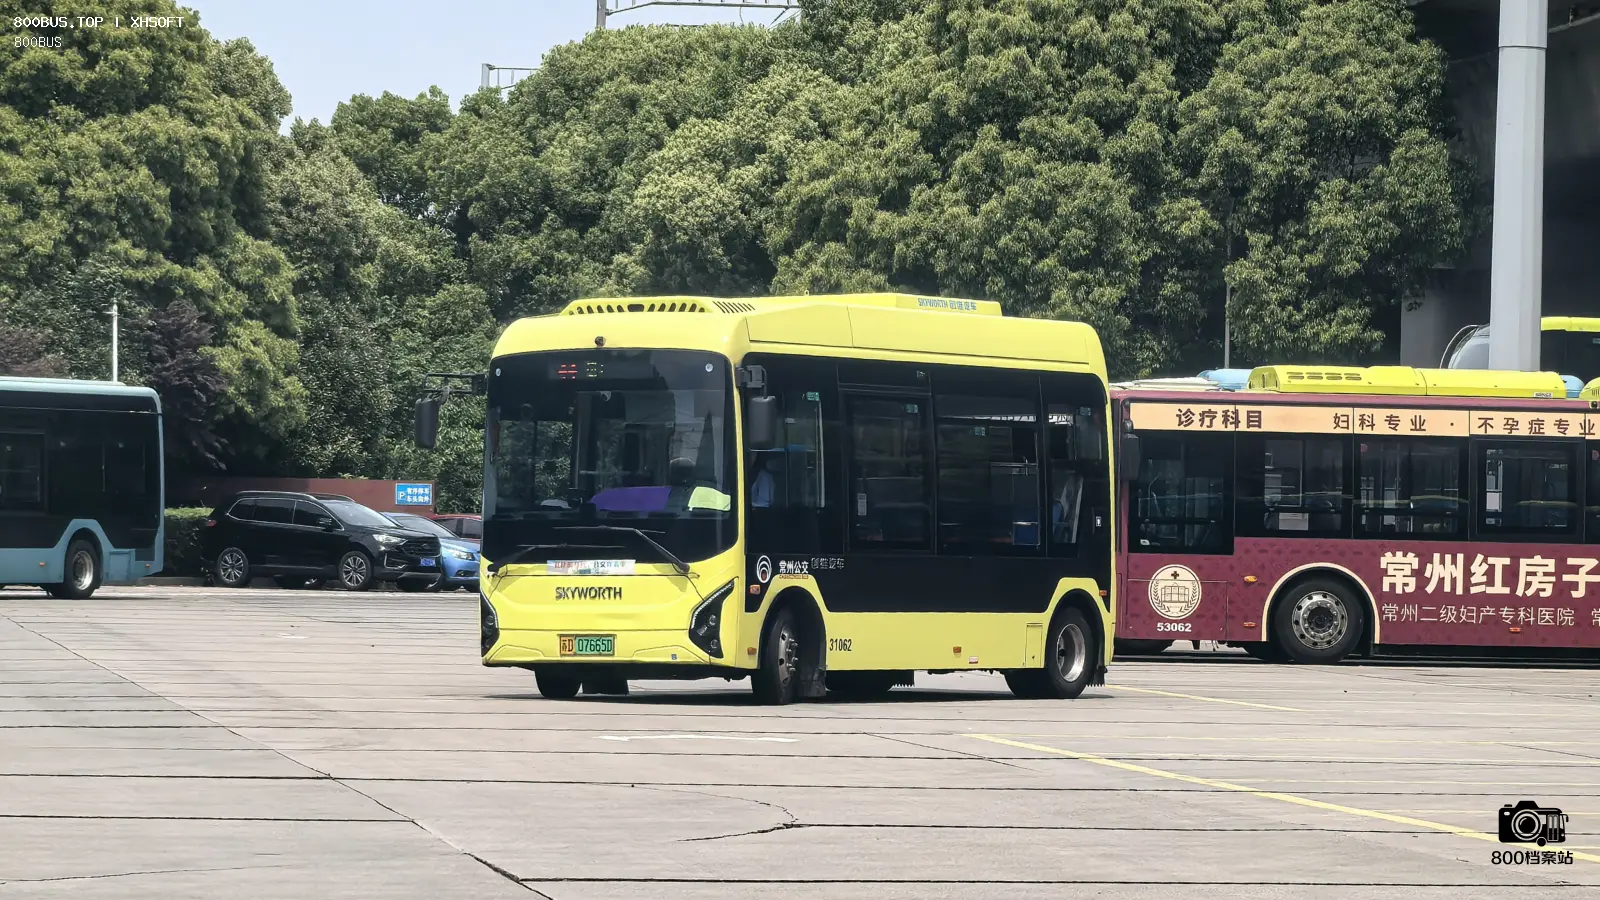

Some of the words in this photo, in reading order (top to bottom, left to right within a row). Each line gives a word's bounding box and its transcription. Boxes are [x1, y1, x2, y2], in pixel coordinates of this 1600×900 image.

[917, 298, 948, 309] SKYWORTH
[1176, 408, 1263, 429] 诊疗科目
[1333, 413, 1427, 432] 妇科专业
[1477, 416, 1596, 436] 不孕症专业
[779, 560, 809, 574] 常州公交
[1380, 551, 1600, 598] 常州红房子
[555, 586, 622, 601] SKYWORTH
[1381, 603, 1575, 626] 常州二级妇产专科医院
[1157, 622, 1192, 632] 53062
[829, 638, 852, 651] 31062
